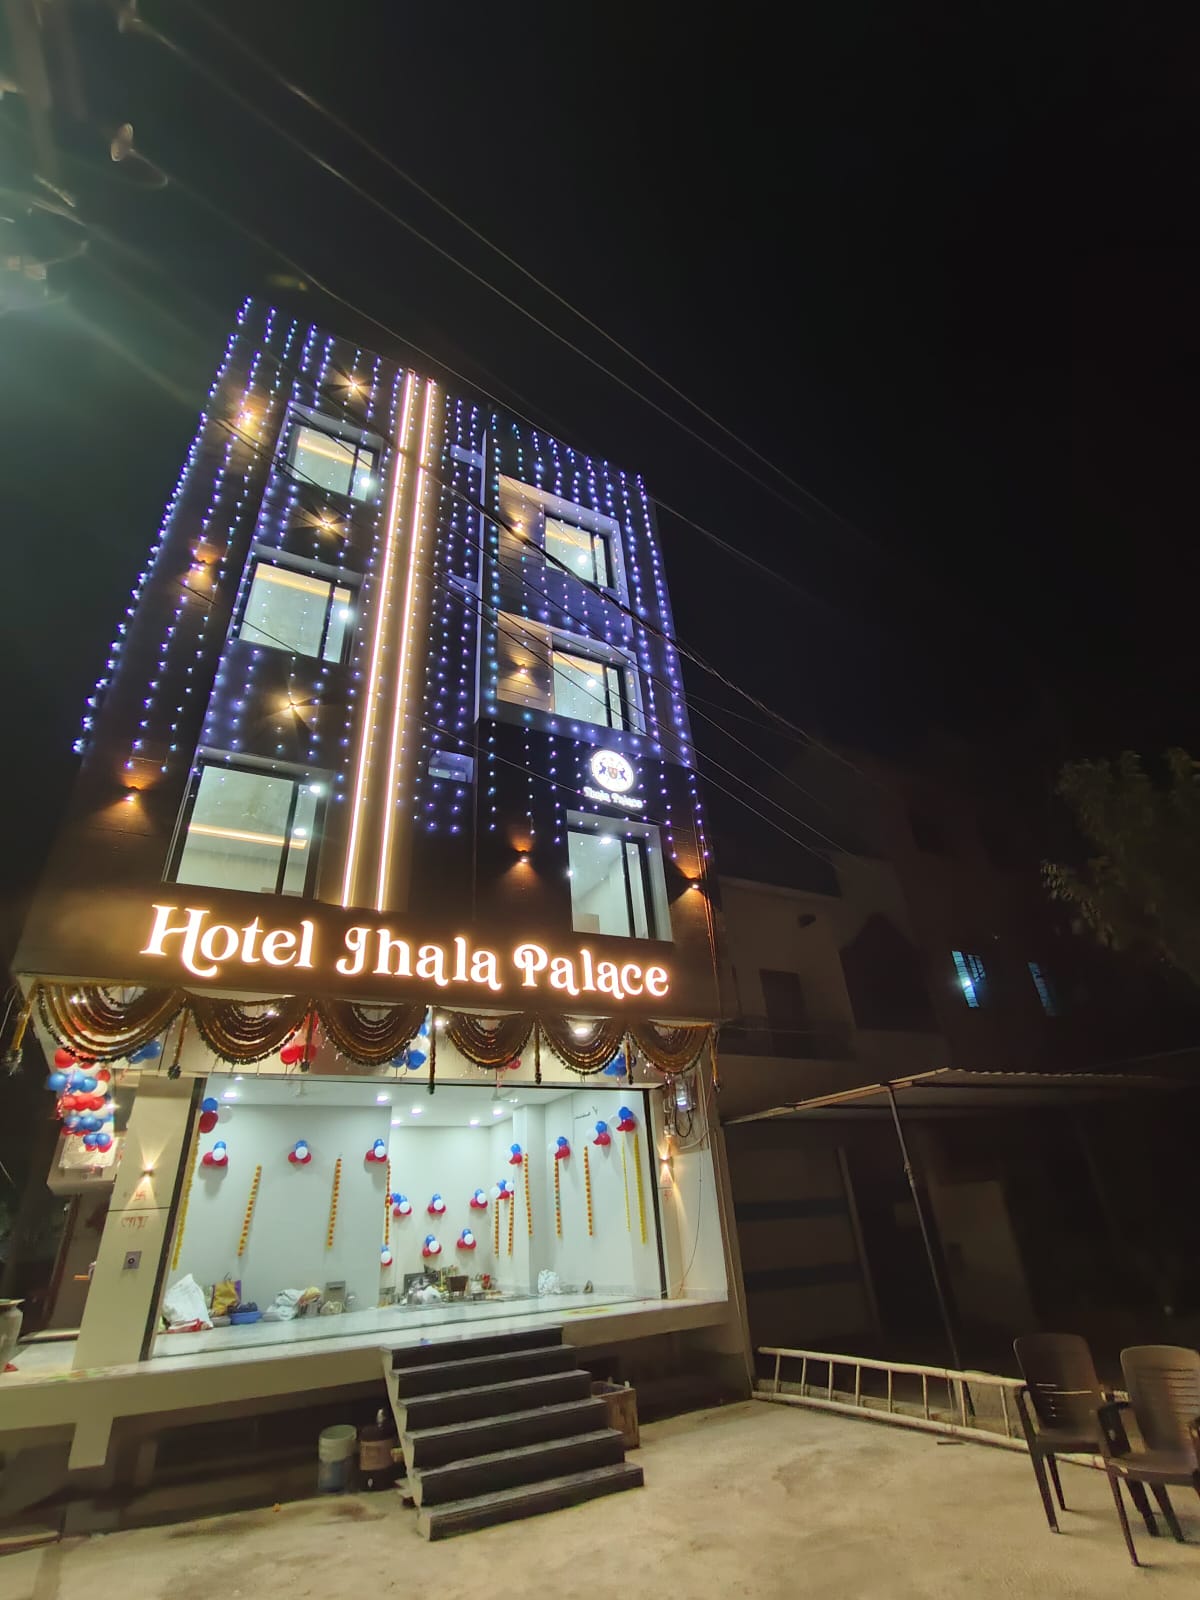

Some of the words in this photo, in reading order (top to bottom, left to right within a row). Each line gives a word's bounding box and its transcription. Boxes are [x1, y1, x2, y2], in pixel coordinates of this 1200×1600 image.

[140, 904, 314, 978] Hotel
[336, 926, 502, 991] Jhala
[513, 943, 669, 1000] Palace
